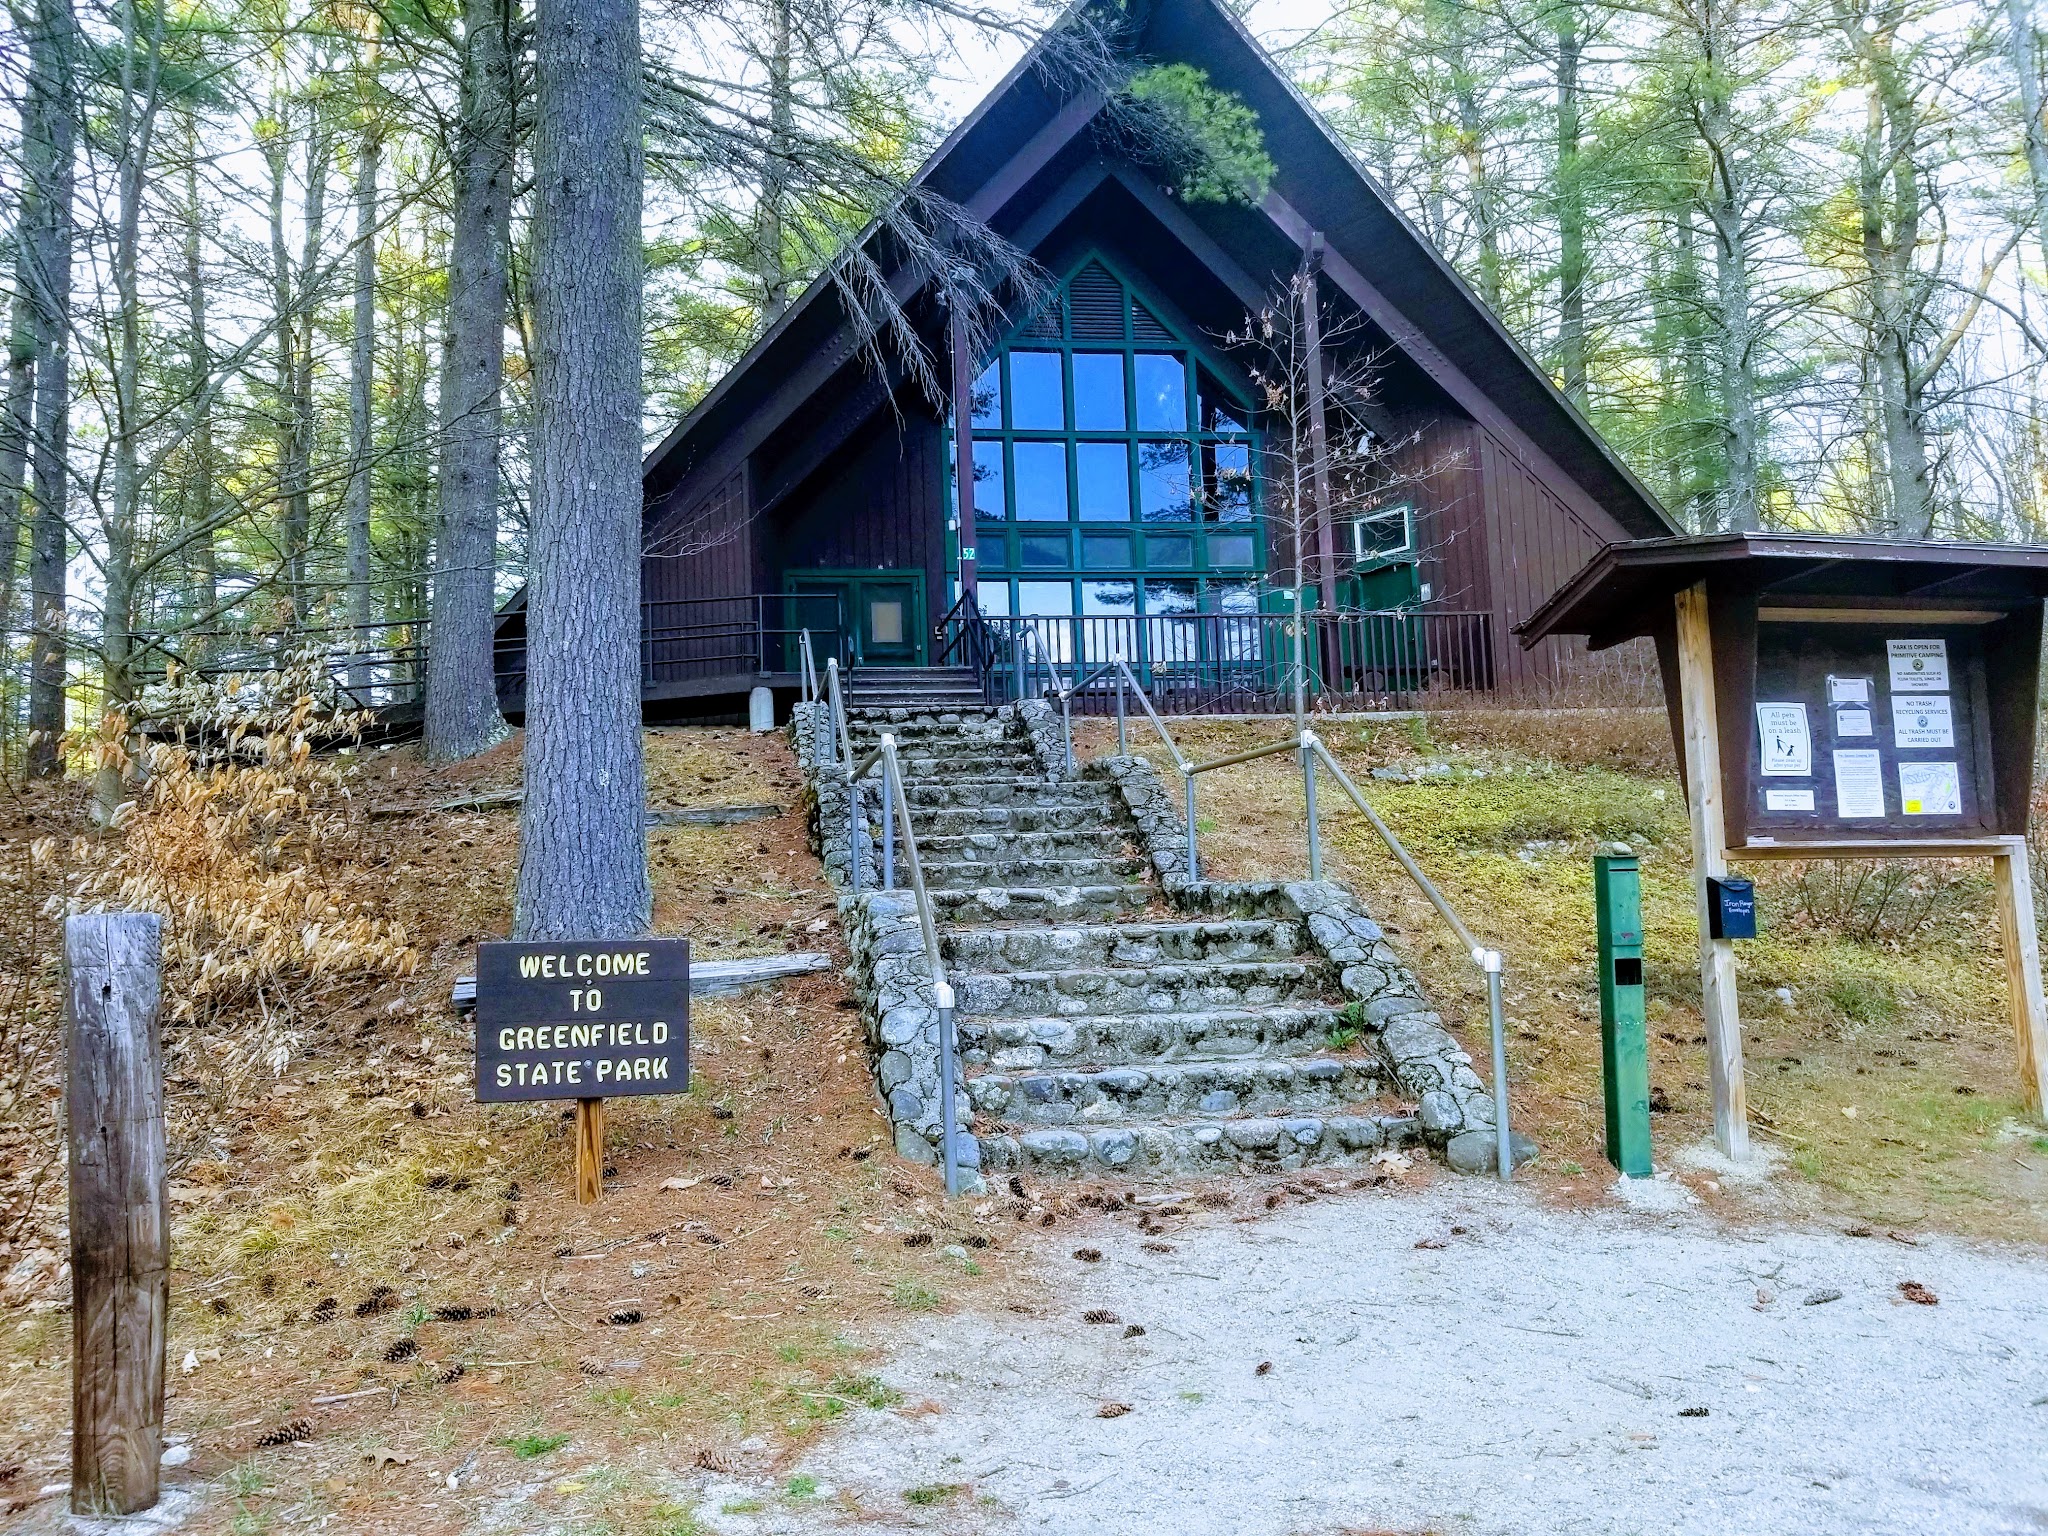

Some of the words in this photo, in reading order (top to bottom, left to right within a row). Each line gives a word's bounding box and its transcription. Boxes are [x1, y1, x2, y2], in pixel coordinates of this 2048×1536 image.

[963, 548, 976, 560] 52
[1724, 899, 1740, 908] Iron
[519, 952, 650, 979] WELCOME
[570, 989, 601, 1012] TO
[499, 1022, 668, 1051] GREENFIELD
[496, 1061, 582, 1087] STATE
[597, 1057, 669, 1083] PARK
